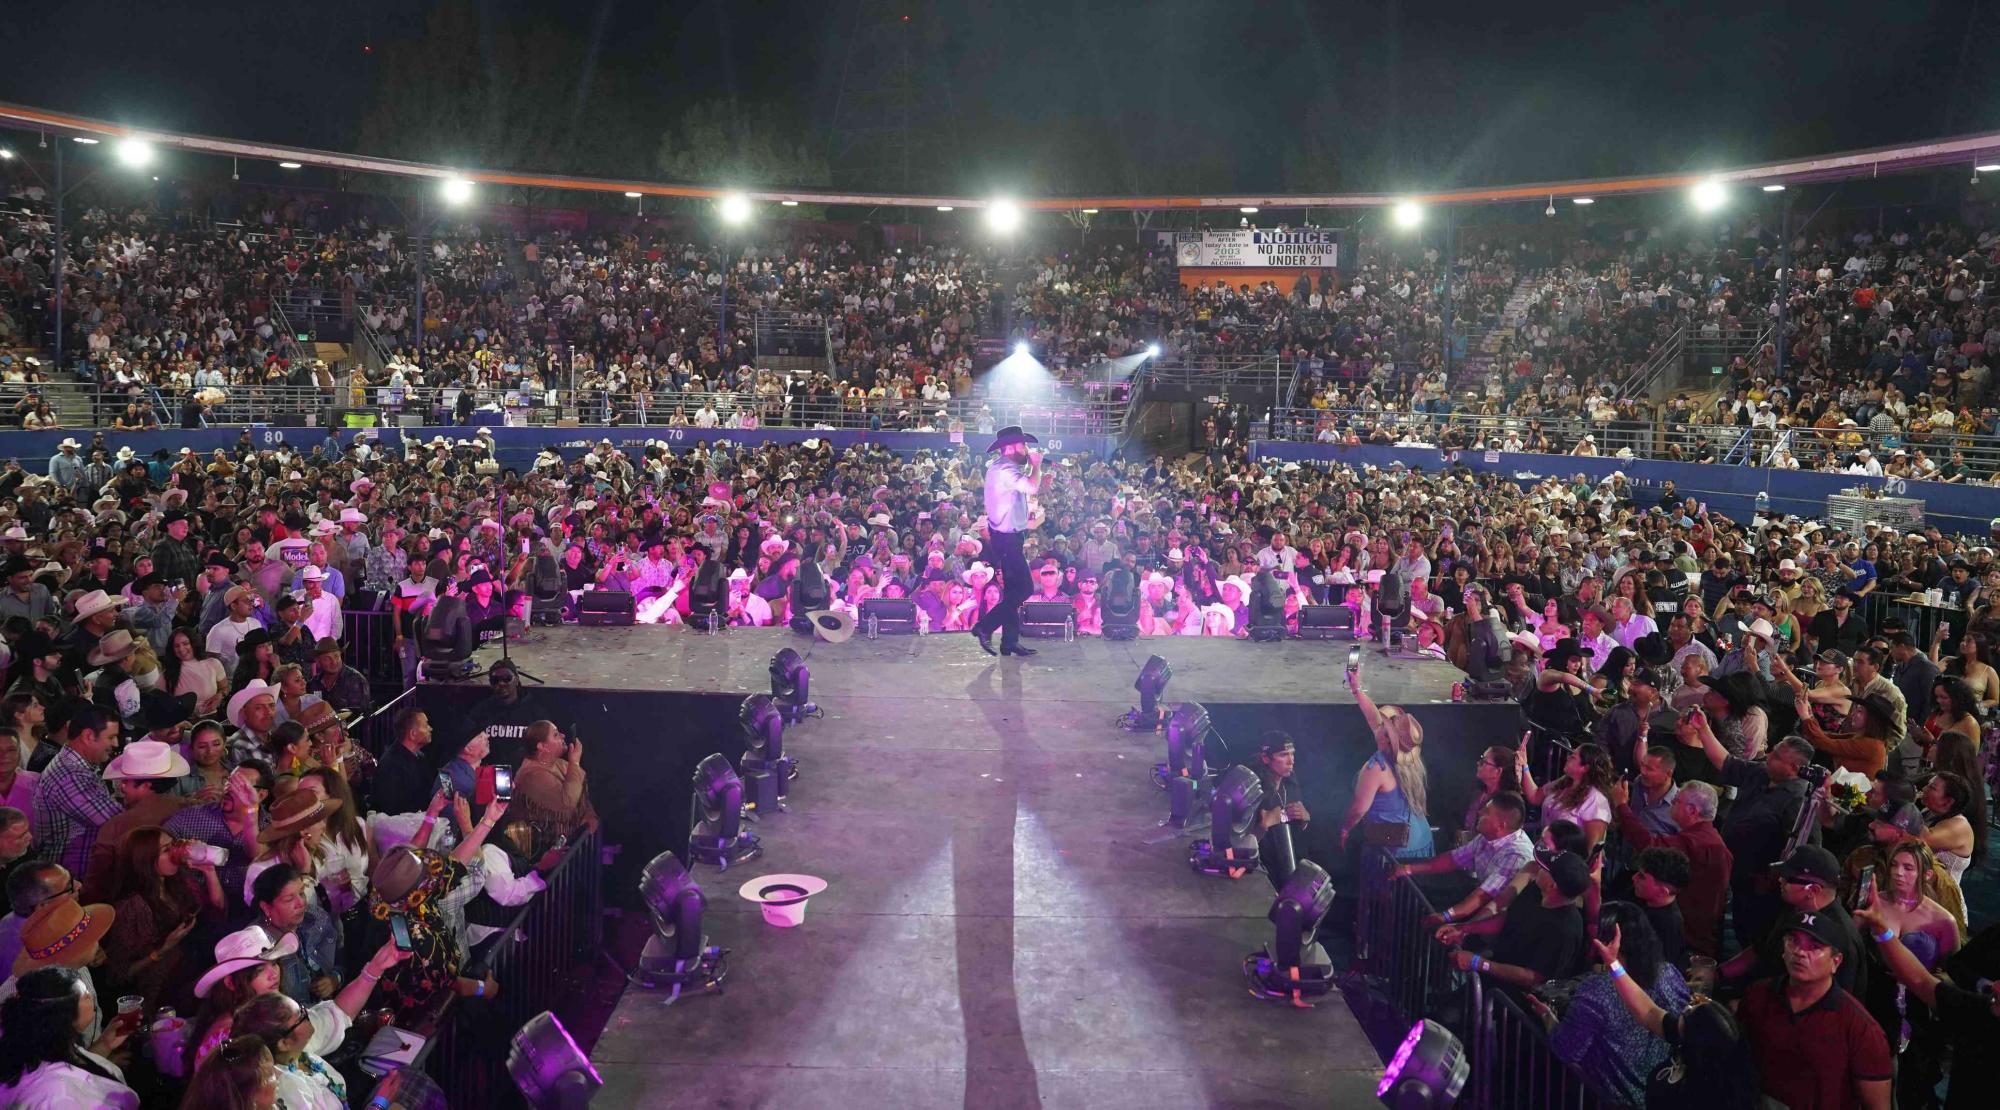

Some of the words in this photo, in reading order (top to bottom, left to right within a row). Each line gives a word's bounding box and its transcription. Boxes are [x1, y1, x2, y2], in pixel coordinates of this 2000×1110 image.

[1260, 232, 1330, 244] NOTICE
[1257, 244, 1273, 255] NO
[1277, 244, 1333, 255] DRINKING
[1268, 255, 1306, 266] UNDER
[1310, 255, 1322, 266] 21
[1221, 392, 1230, 403] 5
[264, 430, 284, 443] 80
[668, 429, 684, 440] 70
[1047, 439, 1063, 450] 60
[485, 724, 529, 738] ECURIT
